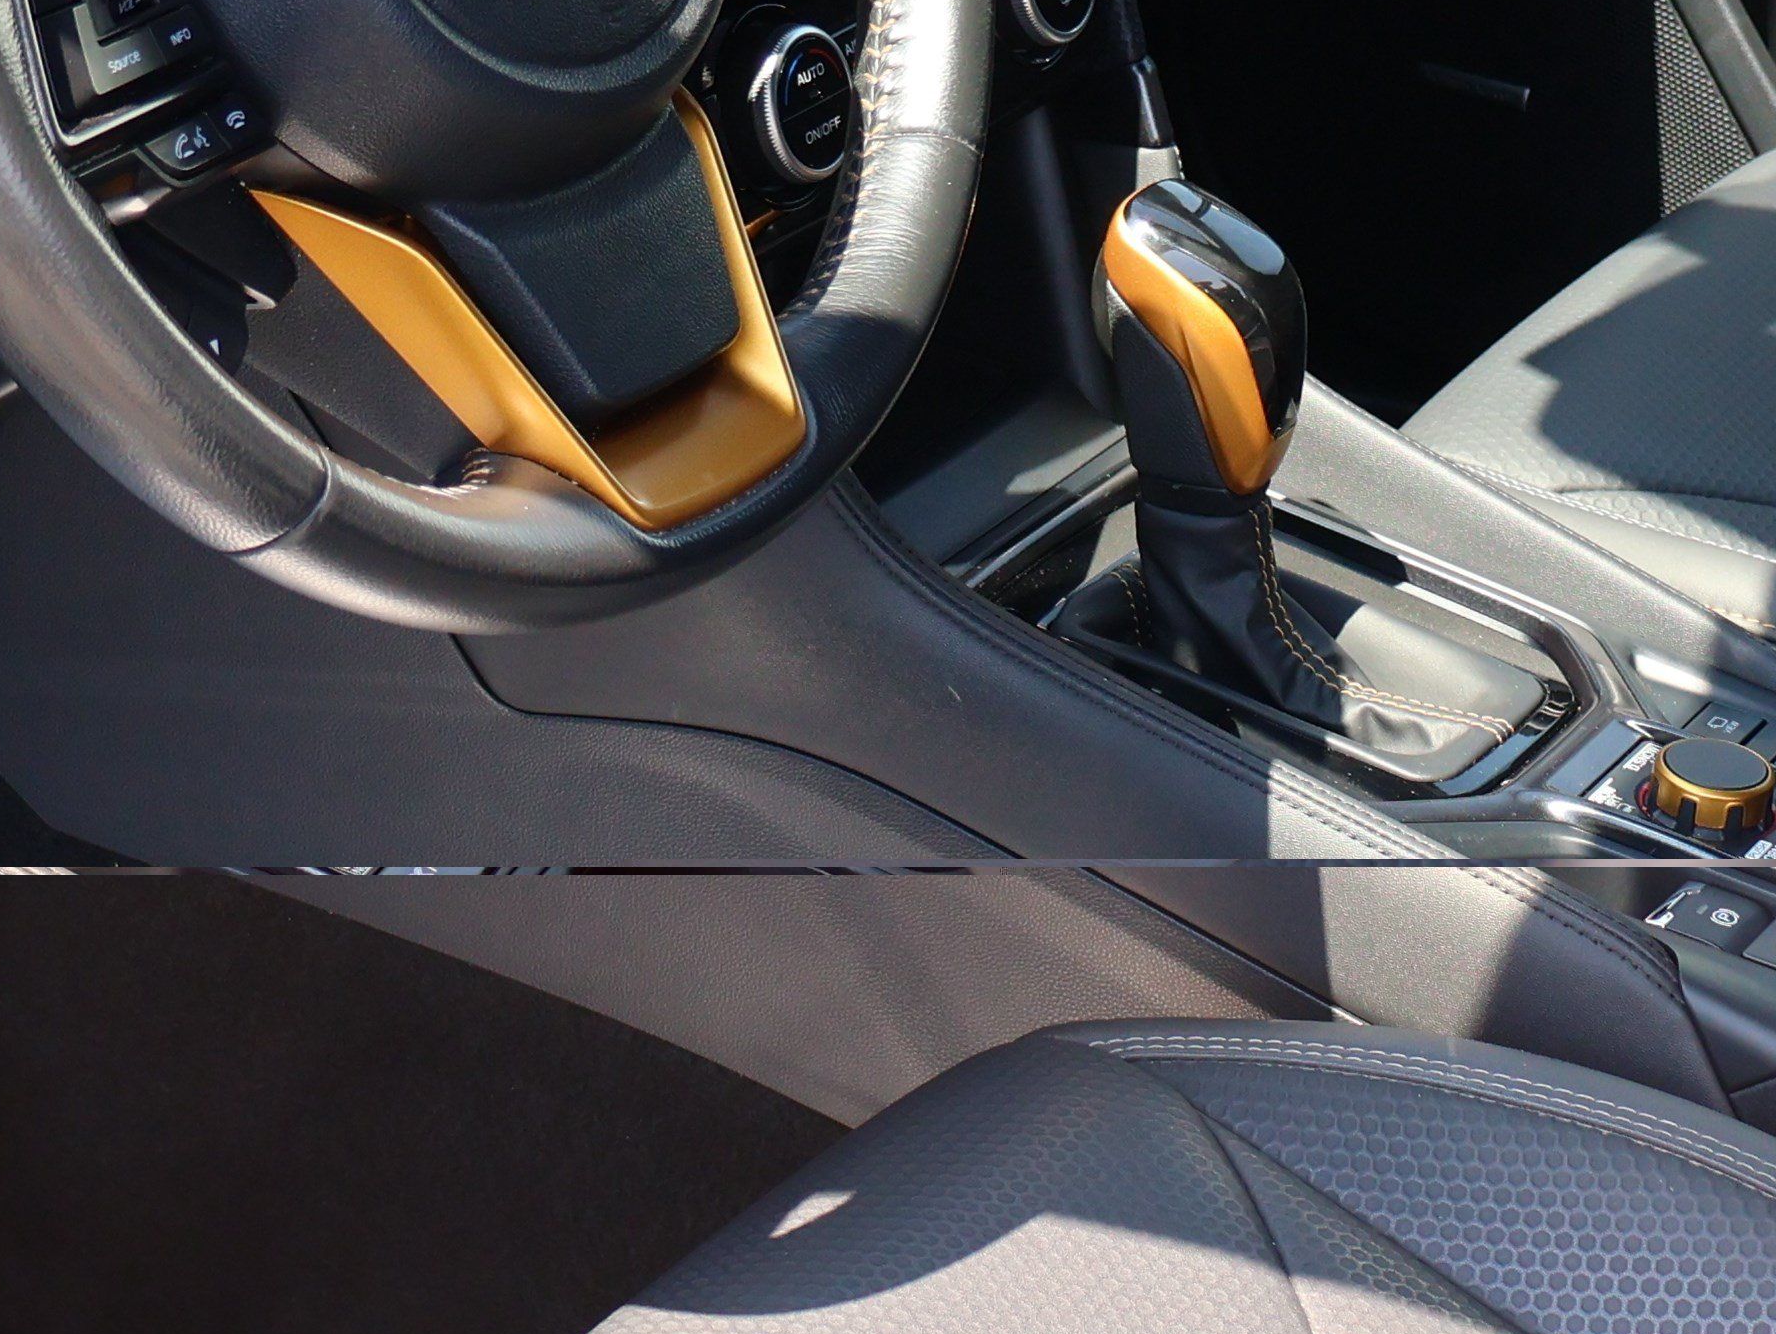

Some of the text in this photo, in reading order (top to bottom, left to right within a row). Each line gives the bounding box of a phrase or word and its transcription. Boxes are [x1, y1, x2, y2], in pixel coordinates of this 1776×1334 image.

[170, 27, 192, 46] INFO
[107, 49, 141, 73] Source
[796, 62, 825, 87] AUTO
[804, 115, 842, 145] ON/OFF
